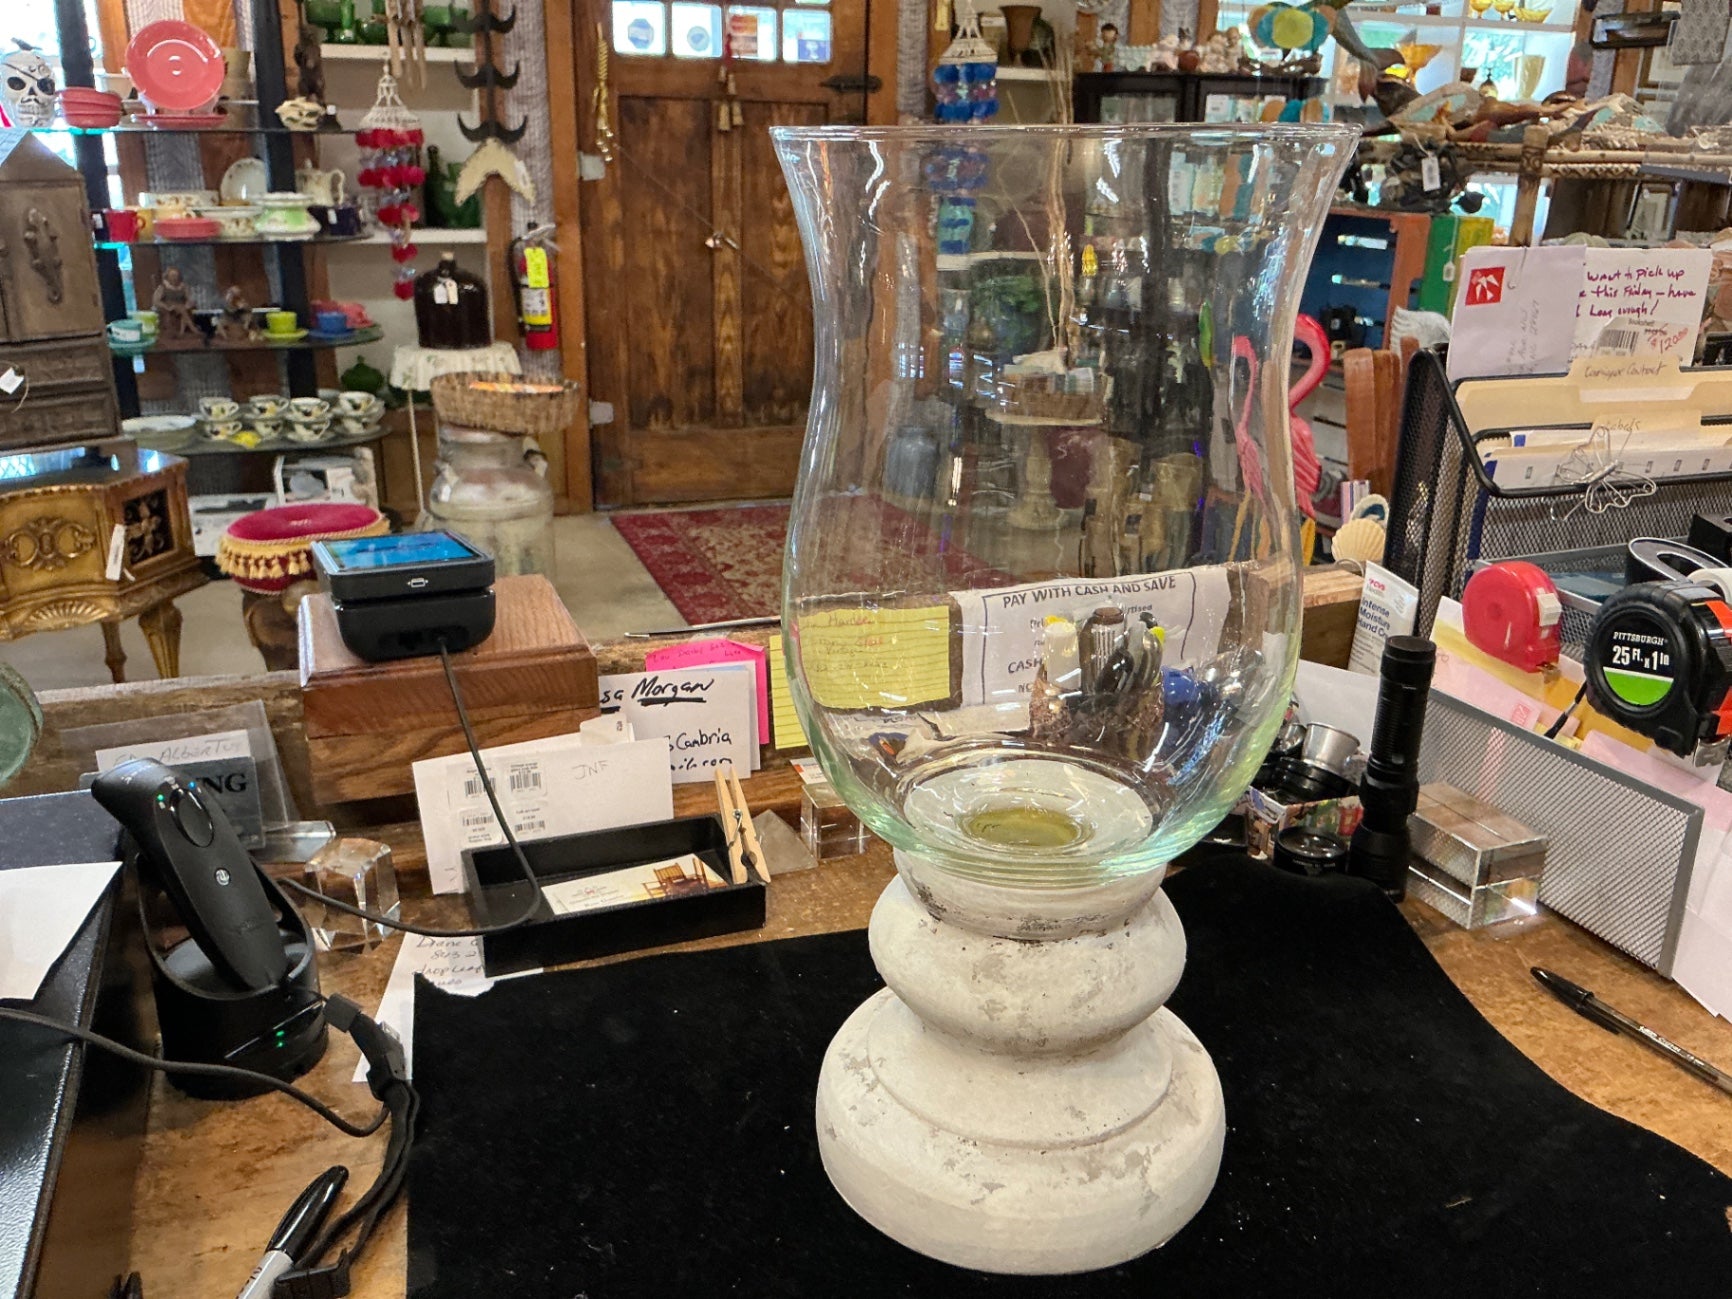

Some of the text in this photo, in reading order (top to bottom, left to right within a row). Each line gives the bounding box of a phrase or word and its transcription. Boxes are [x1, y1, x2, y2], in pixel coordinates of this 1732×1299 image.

[1667, 268, 1685, 281] up
[1591, 284, 1618, 298] this
[1003, 575, 1176, 608] PAY WITH CASH AND SAVE
[1008, 657, 1043, 674] CASH
[1612, 644, 1631, 666] 25
[1652, 650, 1658, 671] 1
[600, 675, 715, 704] sa Morgan
[676, 727, 732, 751] Cambria
